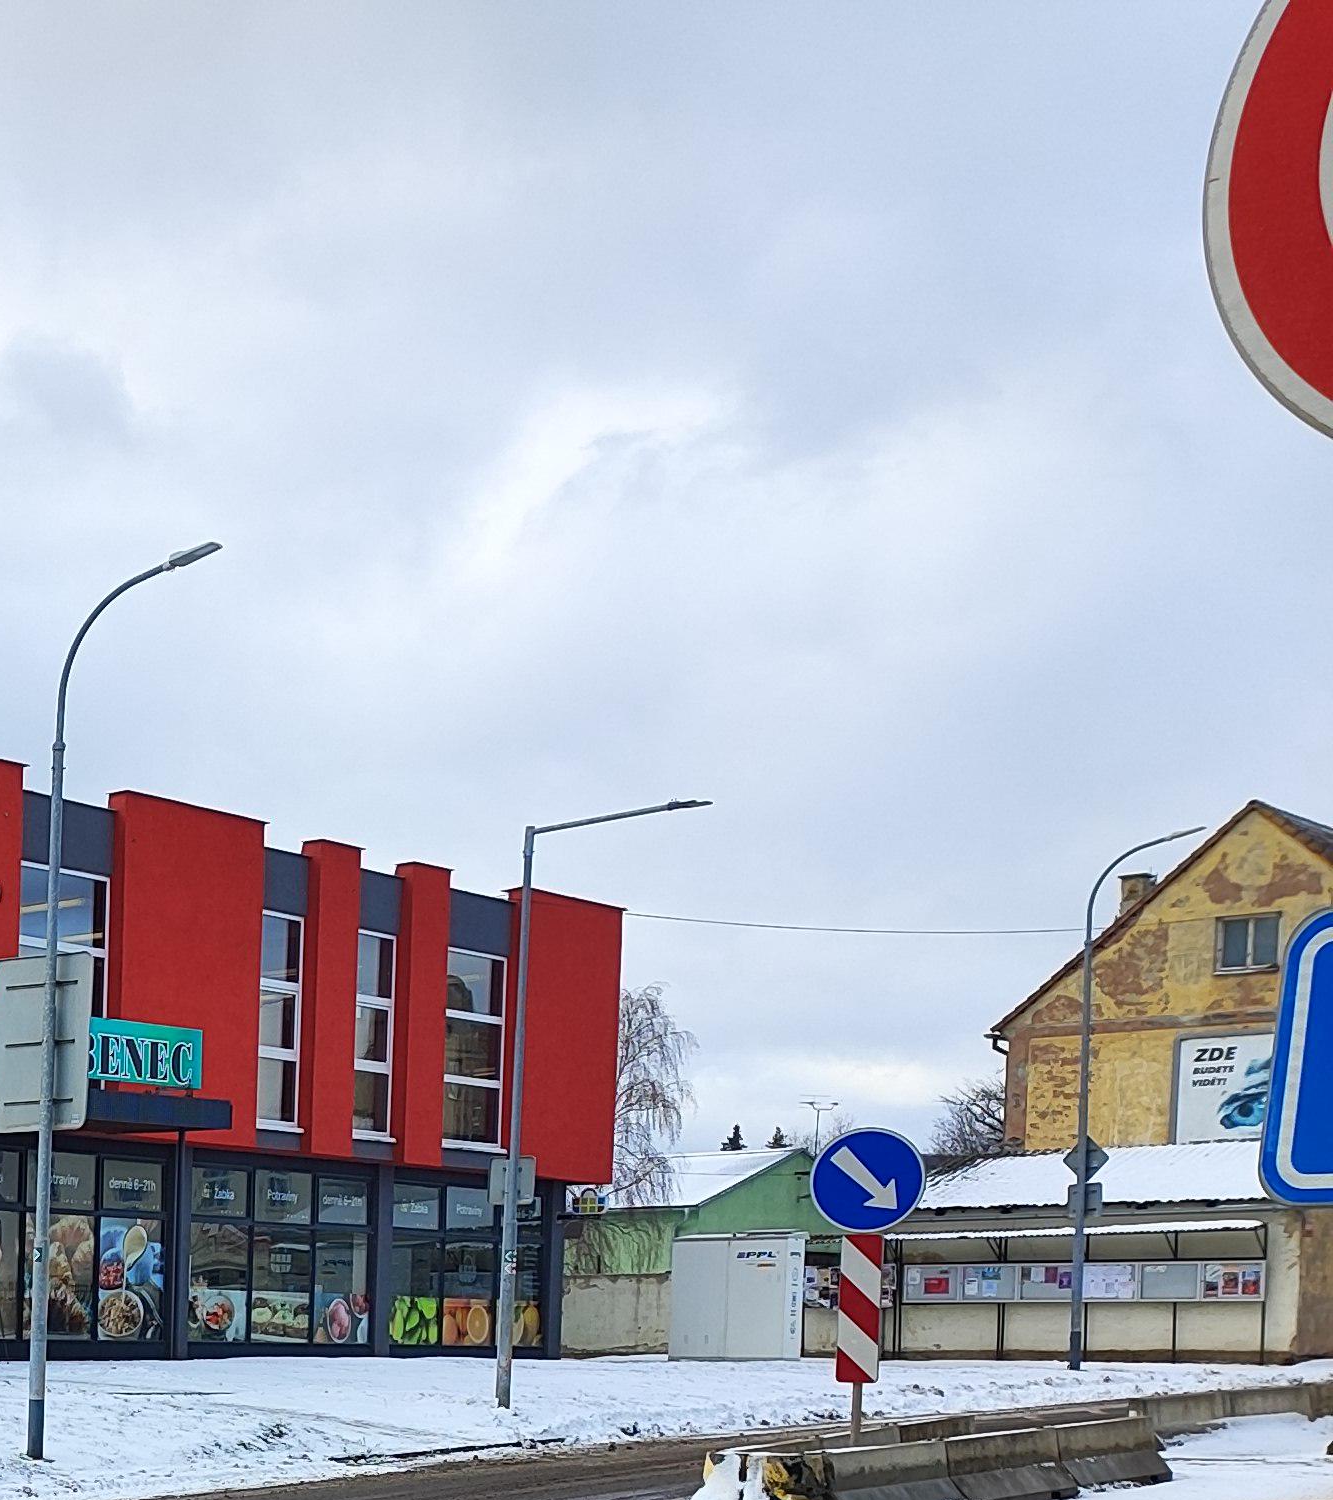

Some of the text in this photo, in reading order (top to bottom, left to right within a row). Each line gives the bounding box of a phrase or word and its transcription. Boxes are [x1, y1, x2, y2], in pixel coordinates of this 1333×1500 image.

[1193, 1046, 1238, 1062] ZDE
[1192, 1065, 1235, 1075] BUDETE
[108, 1176, 133, 1190] denně
[213, 1185, 235, 1200] Žabka
[267, 1189, 299, 1204] Potraviny
